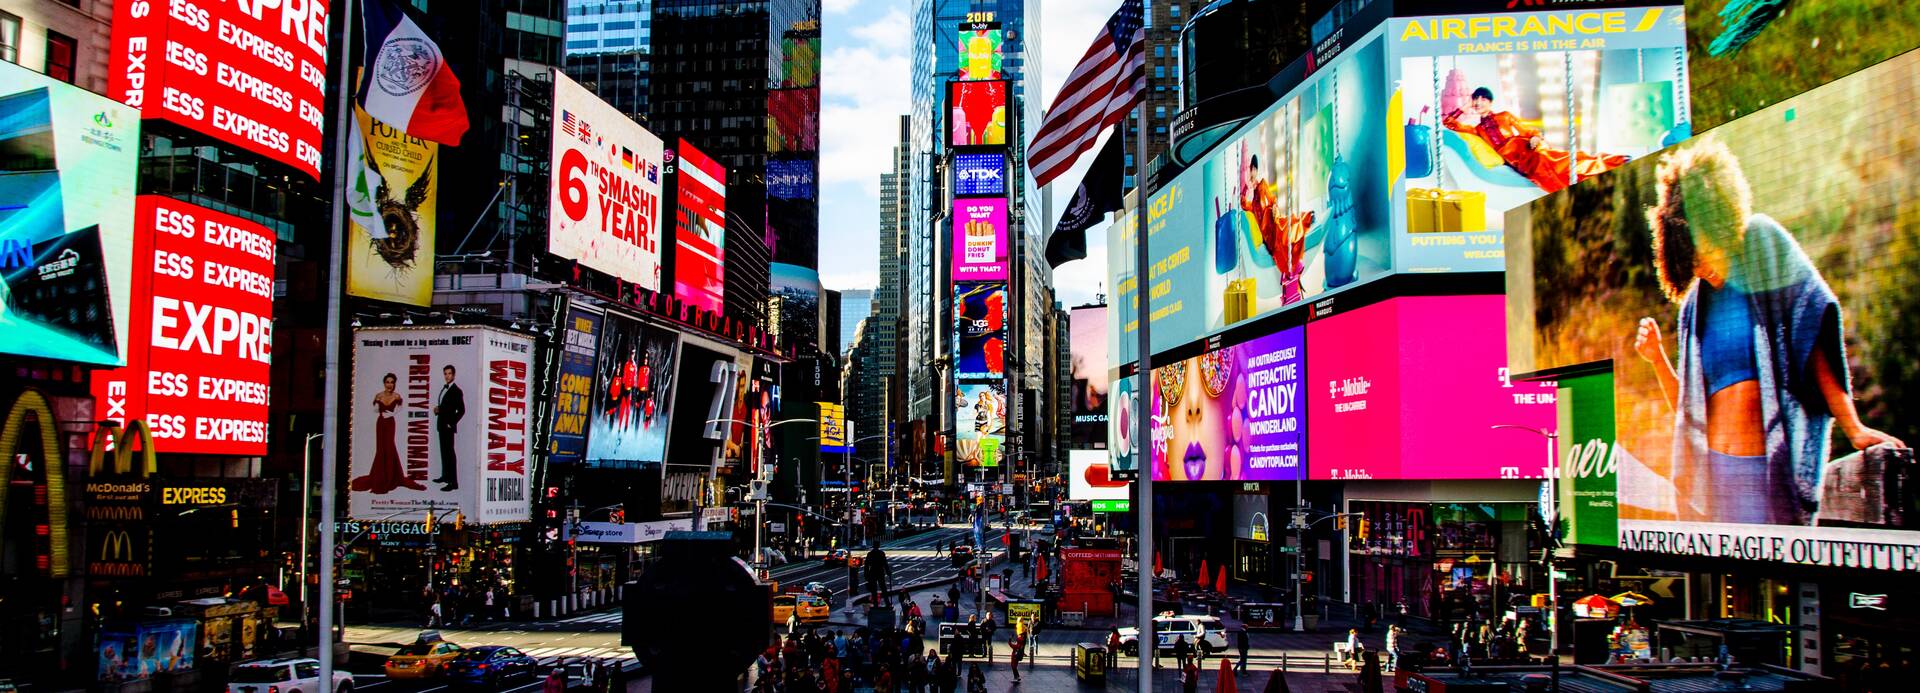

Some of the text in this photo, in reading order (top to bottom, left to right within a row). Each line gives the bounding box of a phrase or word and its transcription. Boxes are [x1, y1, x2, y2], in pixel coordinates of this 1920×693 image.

[966, 12, 994, 23] 2018
[218, 18, 294, 72] EXPRESS
[1458, 38, 1606, 53] FRANCE IS IN THE AIR
[125, 37, 147, 110] EXPR
[217, 62, 293, 112] EXPRESS
[213, 105, 289, 153] EXPRESS
[971, 169, 1001, 180] TDK
[155, 207, 272, 261] ESS EXPRESS
[1411, 235, 1496, 246] PUTTING YOU
[979, 265, 1002, 273] THAT?
[1167, 246, 1190, 271] CENTER
[154, 250, 271, 298] ESS EXPRESS
[151, 296, 273, 365] EXPRE
[972, 319, 989, 328] UGG
[1248, 347, 1297, 369] AN OUTRAGEOUSLY
[148, 370, 266, 406] ESS EXPRESS
[408, 354, 430, 410] PRETTY
[560, 372, 591, 396] COME
[1248, 363, 1297, 388] INTERACTIVE
[1248, 382, 1297, 418] CANDY
[1512, 393, 1536, 404] THE
[487, 359, 508, 471] WOMAN
[506, 360, 527, 476] PRETTY
[554, 413, 587, 434] AWAY
[1250, 417, 1297, 436] WONDERLAND
[146, 414, 266, 443] ESS EXPRESS
[407, 419, 430, 481] WOMAN
[1249, 455, 1298, 469] CANDYTOPIA.COM
[86, 483, 150, 493] McDonald's
[162, 487, 226, 505] EXPRESS
[487, 478, 497, 501] THE
[499, 478, 524, 502] MUSICAL
[605, 529, 623, 537] store
[1619, 530, 1920, 573] AMERICAN EAGLE OUTFITTE
